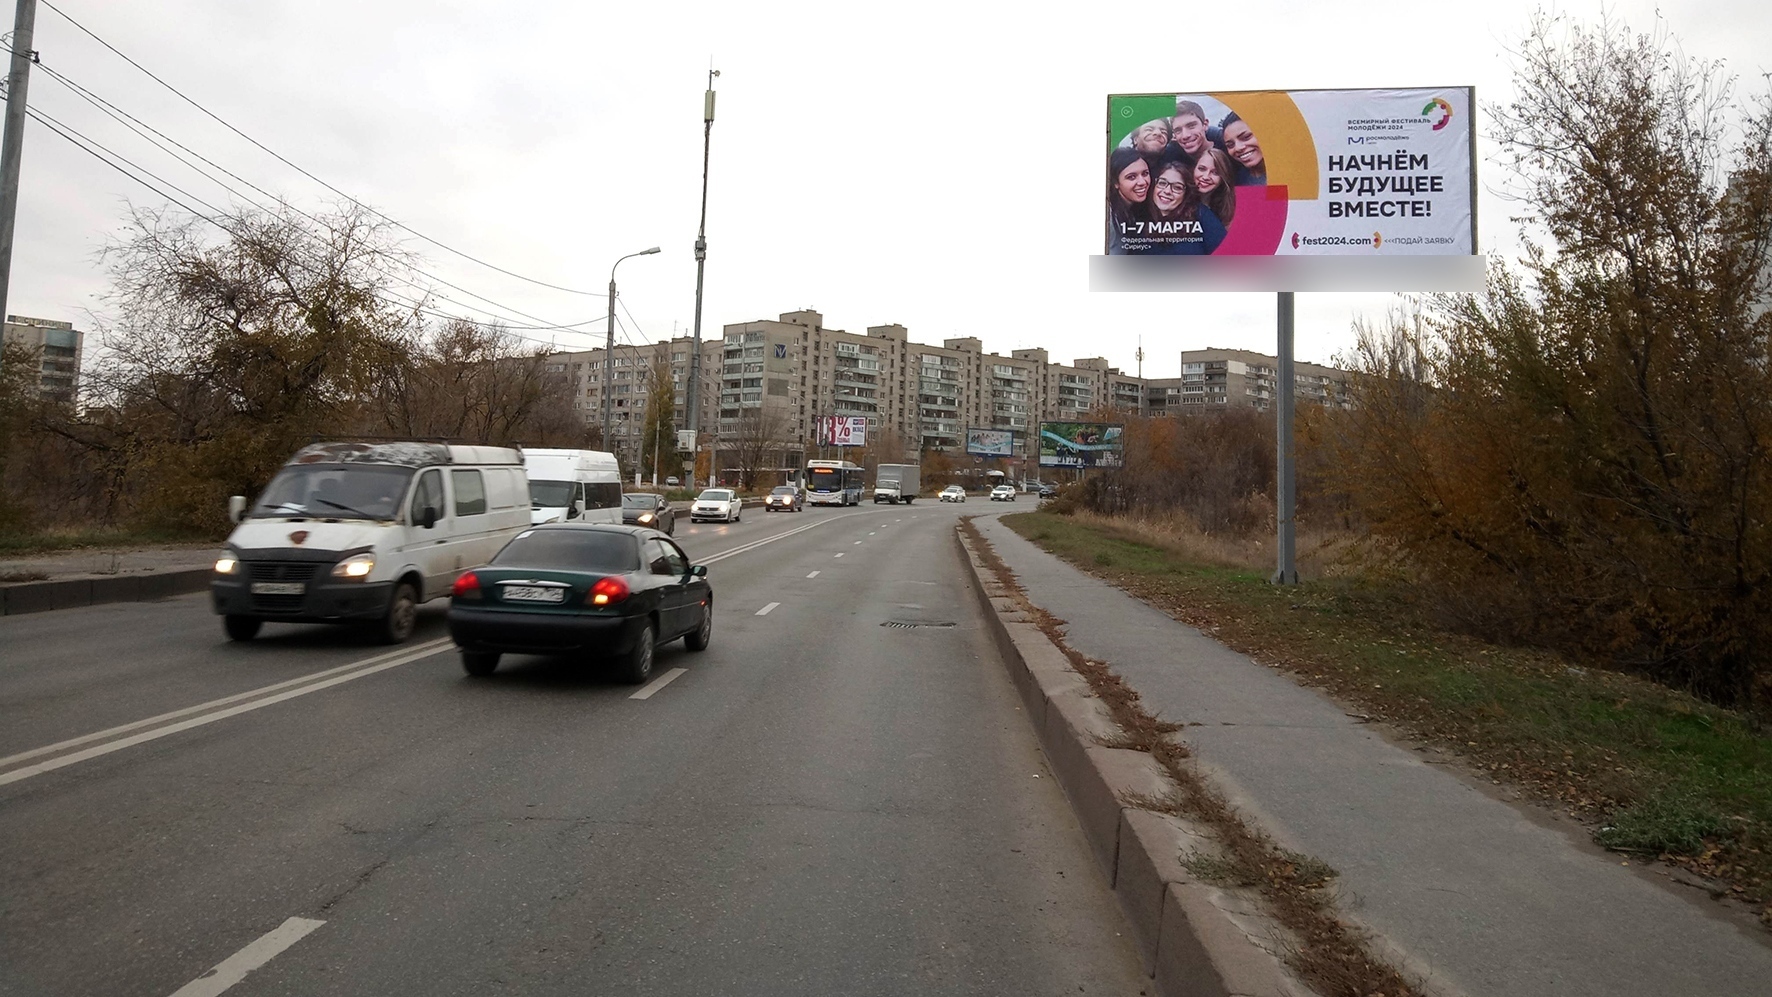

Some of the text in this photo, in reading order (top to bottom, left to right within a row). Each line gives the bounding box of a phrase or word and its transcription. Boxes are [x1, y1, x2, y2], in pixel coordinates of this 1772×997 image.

[1329, 149, 1428, 171] НАЧНЁМ
[1328, 176, 1443, 196] БУДУЩЕЕ
[1328, 201, 1431, 217] ВМЕСТЕ!
[1148, 221, 1204, 234] МАРТА
[1120, 236, 1204, 244] Федеральная территория
[1302, 236, 1372, 246] fest2024.com
[1424, 237, 1455, 245] ЗАЯВКУ
[1121, 243, 1152, 251] «Сириус»
